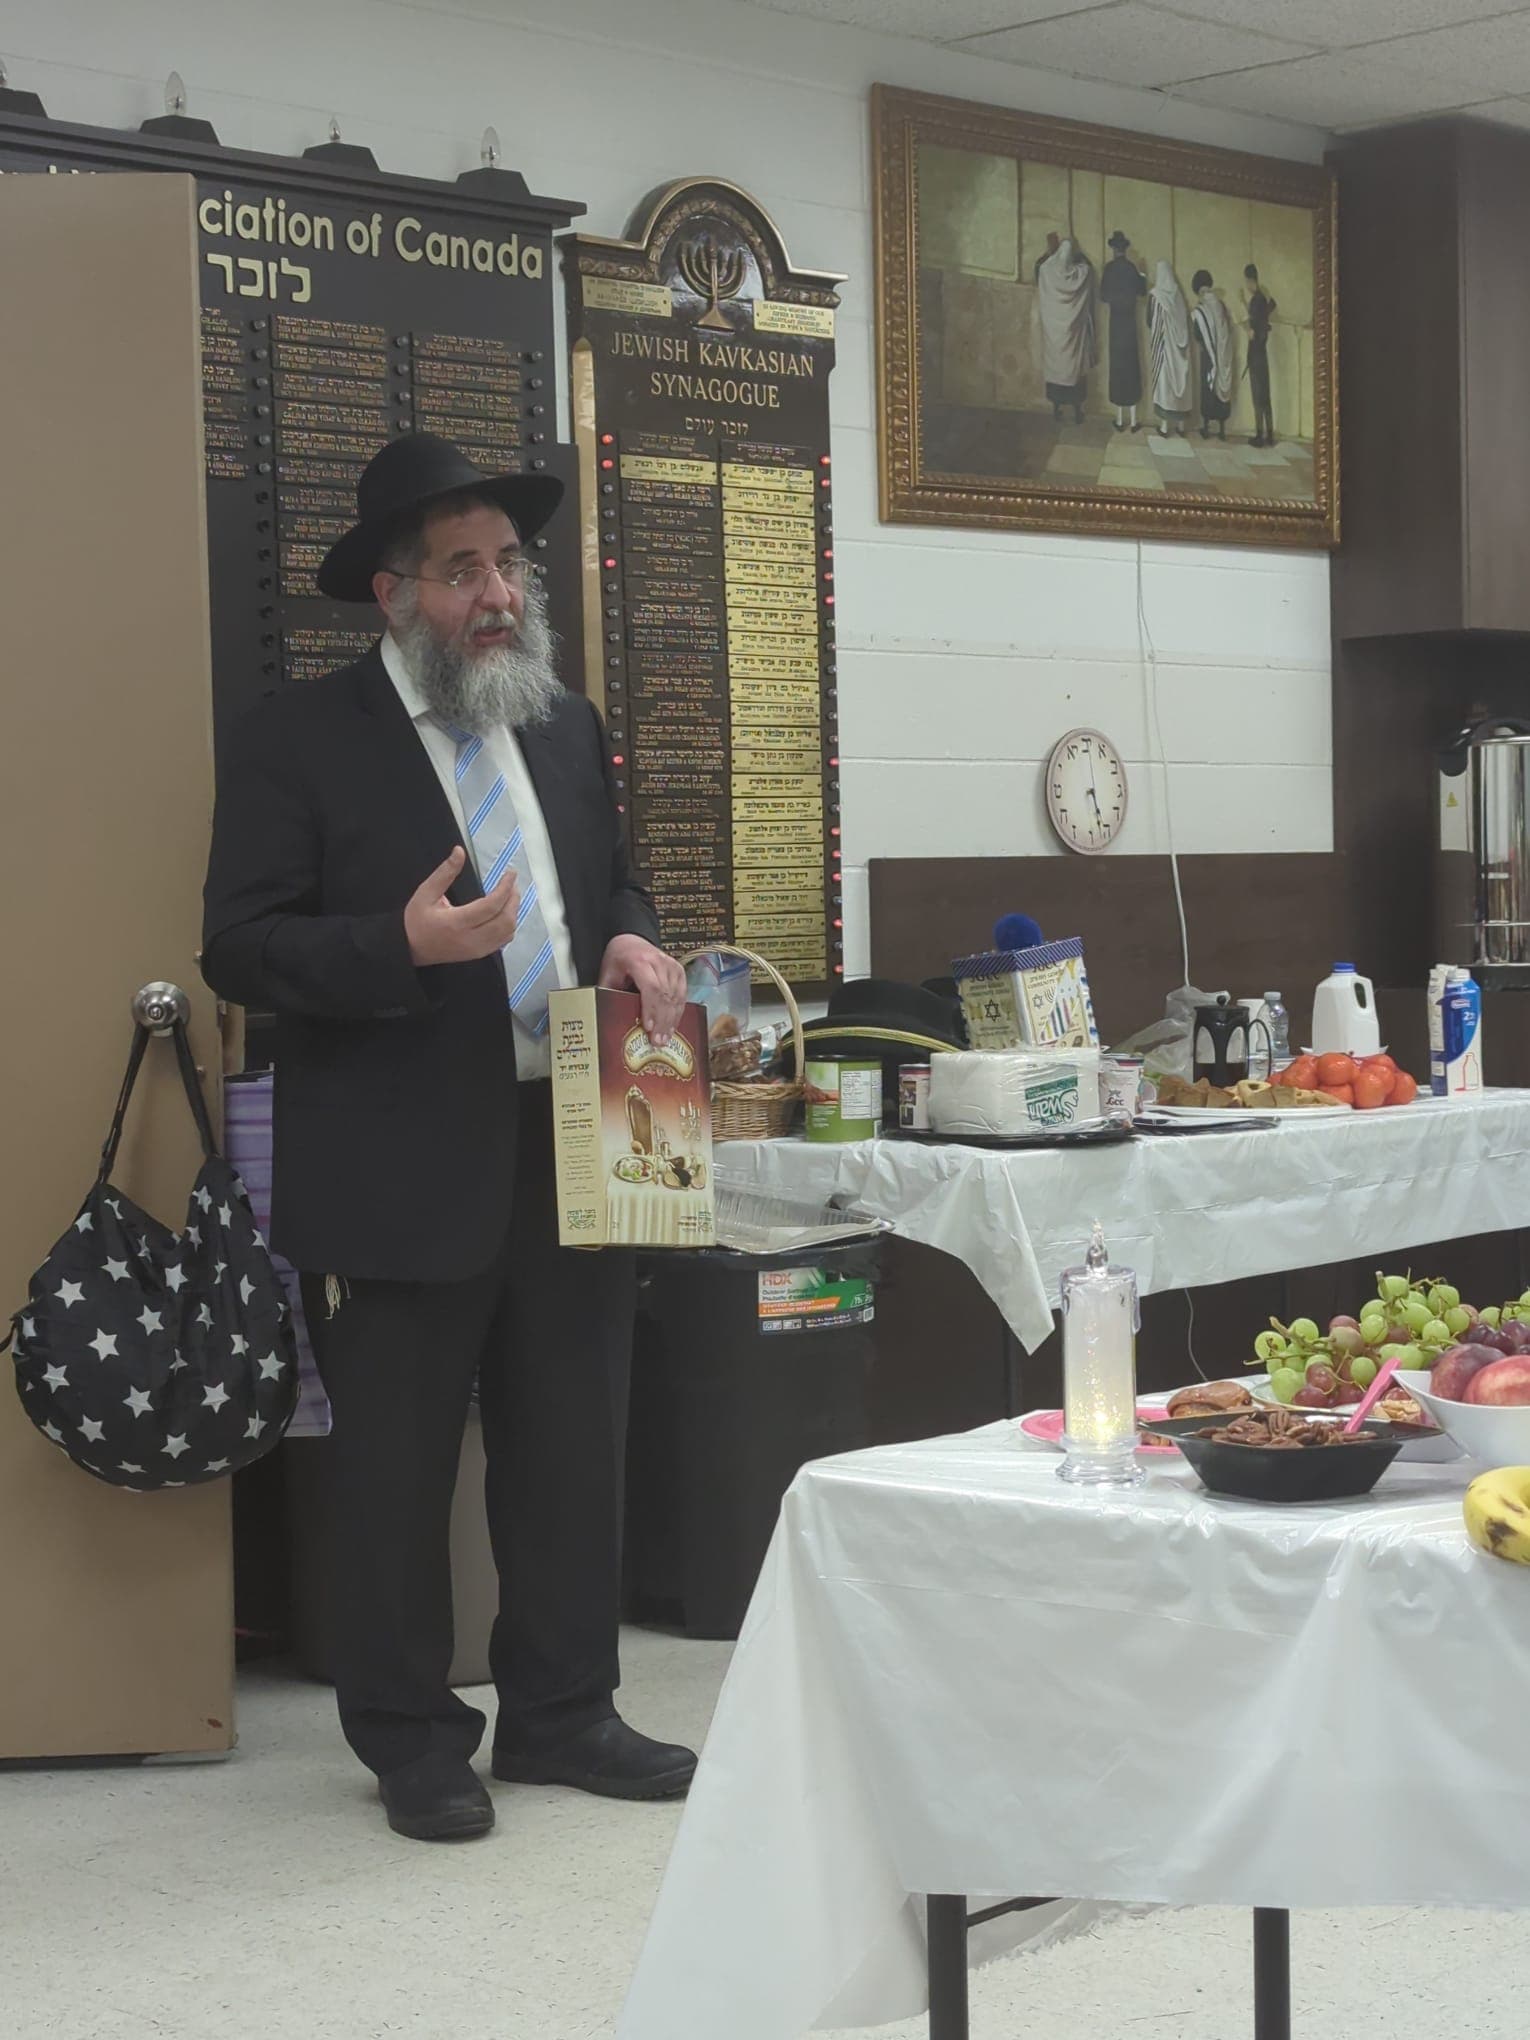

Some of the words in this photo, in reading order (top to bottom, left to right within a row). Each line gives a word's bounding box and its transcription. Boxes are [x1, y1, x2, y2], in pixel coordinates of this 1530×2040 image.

[346, 212, 382, 258] of
[395, 217, 543, 280] Canada
[611, 332, 689, 364] JEWISH
[699, 342, 814, 377] KAVKASIAN
[650, 372, 780, 408] SYNAGOGUE
[1097, 743, 1107, 759] א
[1110, 759, 1118, 775] ב
[1053, 783, 1062, 799] ט
[1117, 783, 1123, 798] ג
[1112, 806, 1120, 821] ד
[1027, 1089, 1079, 1123] Swan
[762, 1272, 793, 1287] HDX
